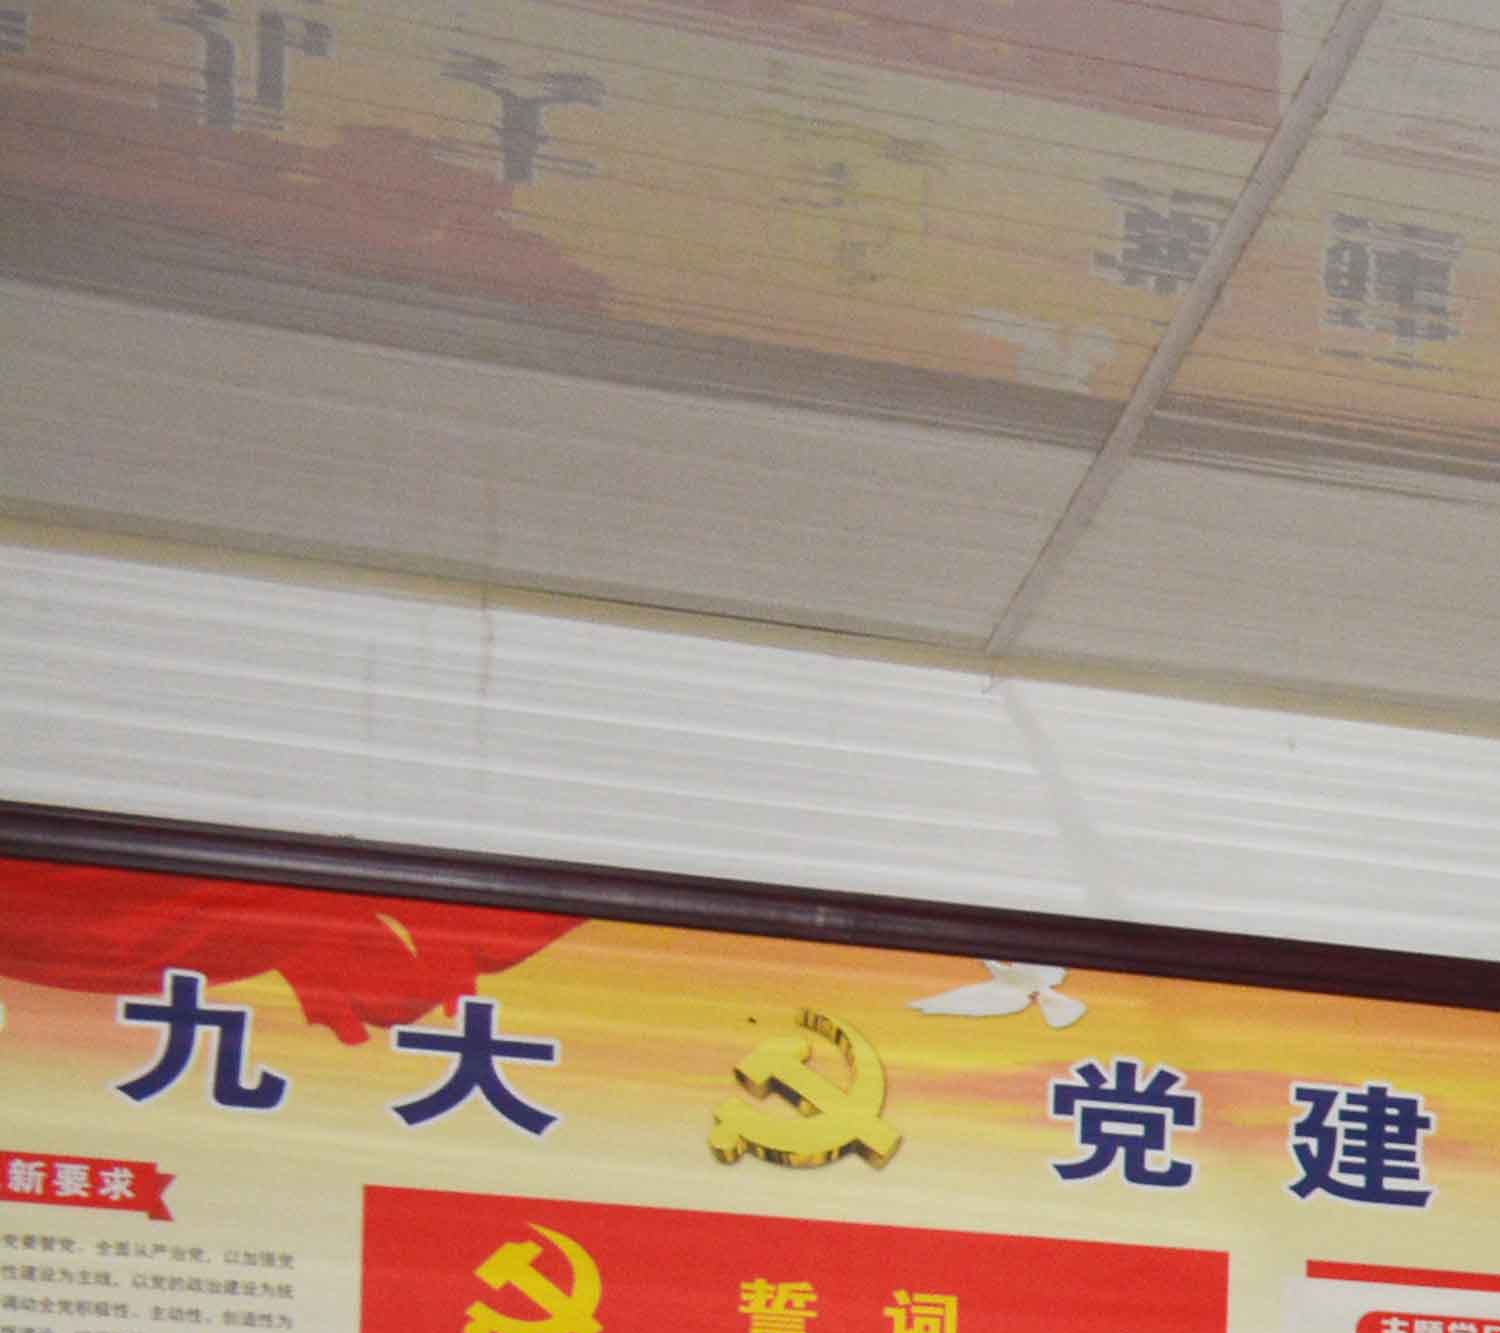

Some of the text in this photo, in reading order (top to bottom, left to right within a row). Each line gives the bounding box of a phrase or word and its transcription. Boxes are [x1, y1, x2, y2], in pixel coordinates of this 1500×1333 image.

[116, 974, 560, 1136] 九大
[6, 1158, 136, 1201] 新要求
